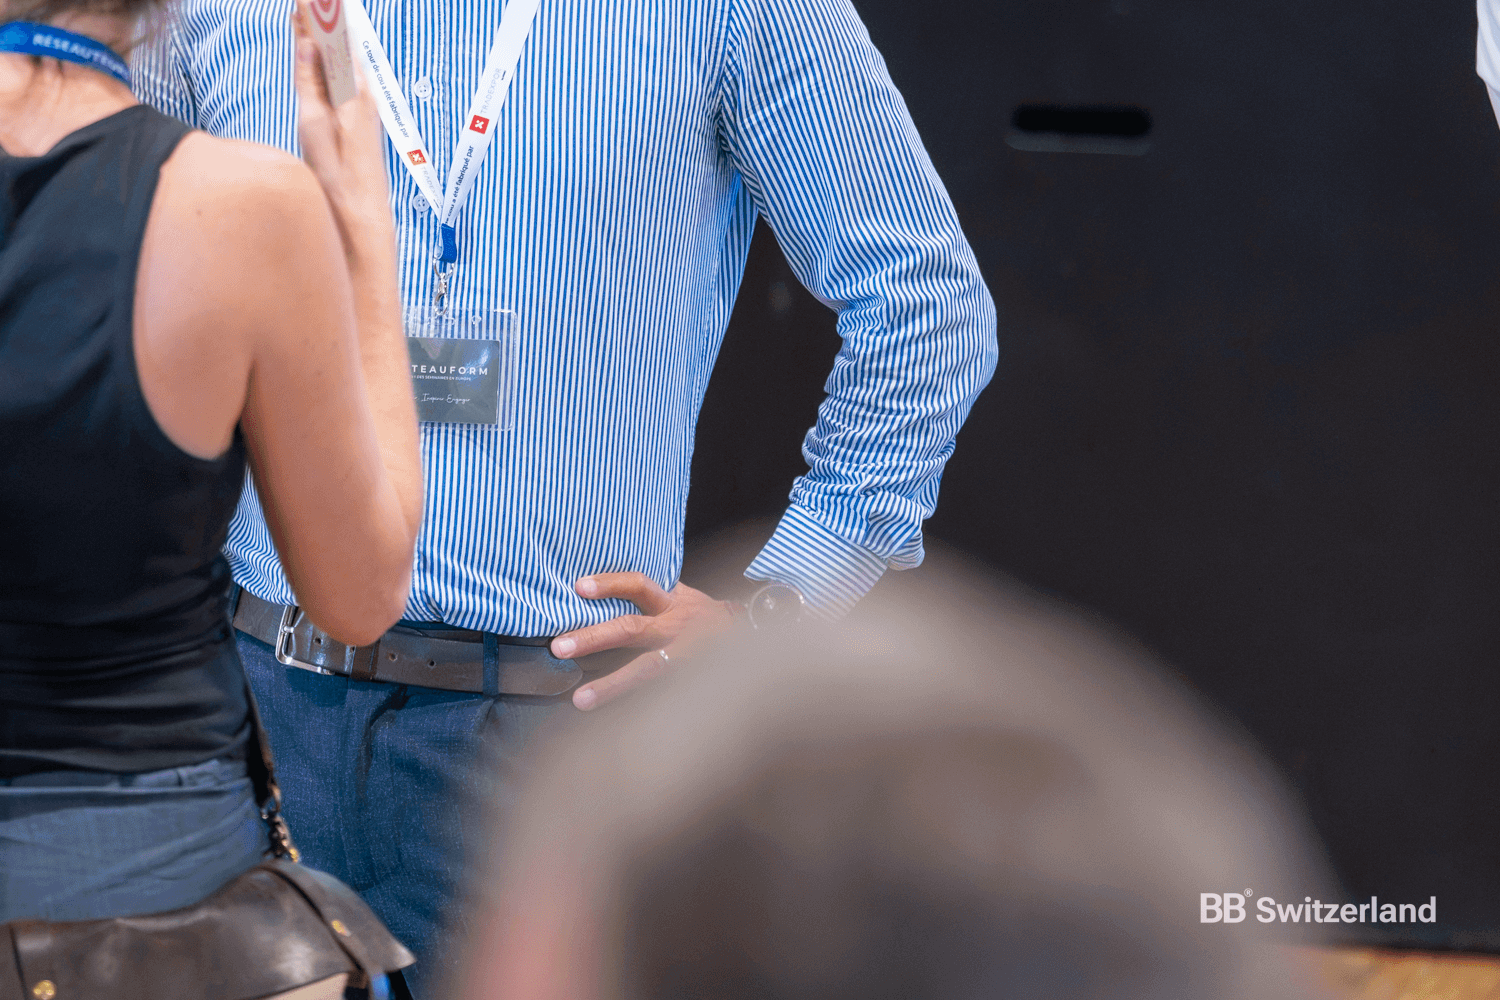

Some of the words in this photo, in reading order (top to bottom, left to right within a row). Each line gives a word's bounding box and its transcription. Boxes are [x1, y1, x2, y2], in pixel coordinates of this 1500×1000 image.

[362, 40, 370, 50] Ce
[366, 50, 376, 64] tour
[372, 63, 380, 74] de
[376, 73, 385, 86] cou
[383, 89, 393, 101] été
[389, 100, 404, 128] fabriqué
[400, 126, 409, 138] par
[456, 157, 470, 188] fabriqué
[466, 145, 474, 157] par
[411, 364, 488, 375] TEAUFORM
